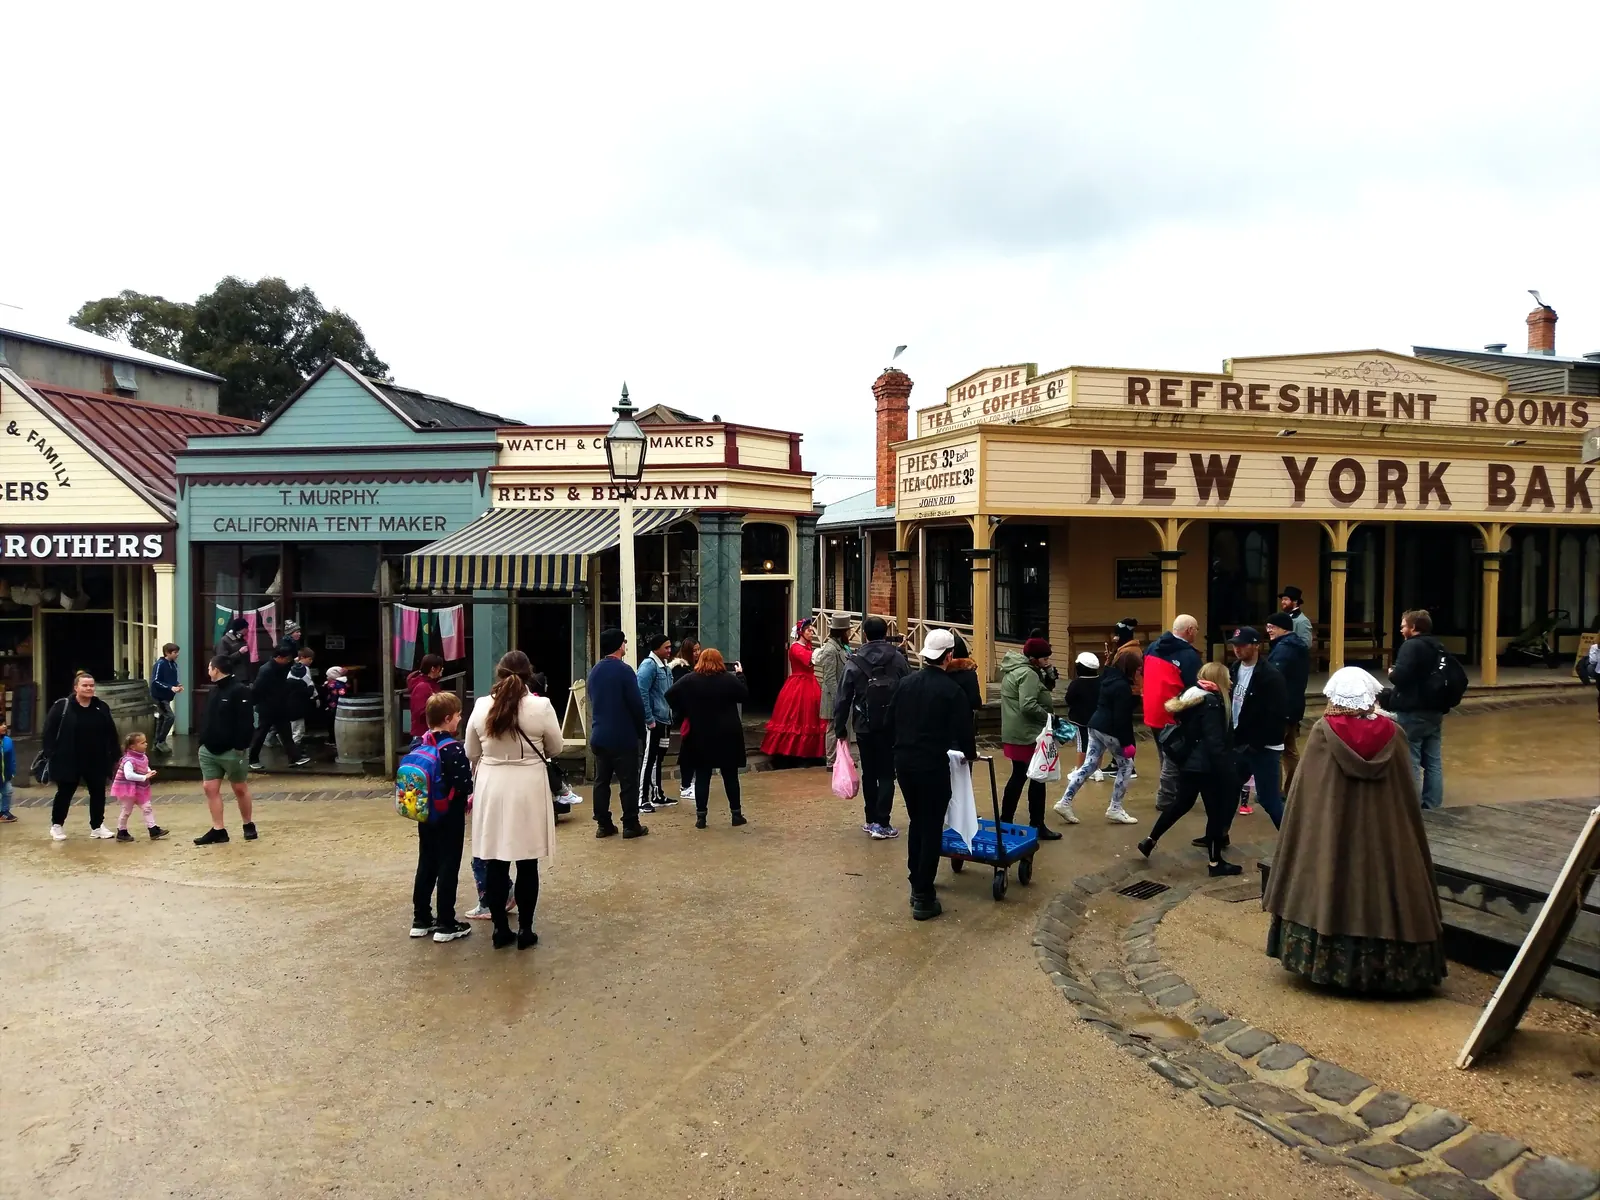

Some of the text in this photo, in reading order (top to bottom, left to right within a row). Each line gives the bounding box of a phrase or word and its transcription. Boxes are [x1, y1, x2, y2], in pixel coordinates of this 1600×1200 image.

[957, 371, 1020, 402] HOT PIE
[927, 410, 953, 429] TEA
[962, 406, 971, 418] OR
[982, 386, 1041, 415] COFFEE
[1127, 376, 1589, 428] REFRESHMENT ROOMS
[6, 420, 71, 489] & FAMILY
[507, 438, 566, 451] WATCH
[577, 438, 587, 450] &
[650, 436, 714, 448] MAKERS
[907, 452, 938, 473] PIES
[902, 476, 920, 493] TEA
[926, 470, 962, 490] COFFEE
[1091, 449, 1596, 509] NEW YORK BAK
[0, 481, 49, 501] ERS
[498, 487, 555, 501] REES
[567, 486, 581, 501] &
[919, 495, 956, 508] JOHN REID
[213, 516, 447, 533] CALIFORNIA TENT MAKER
[0, 534, 163, 558] ROTHERS
